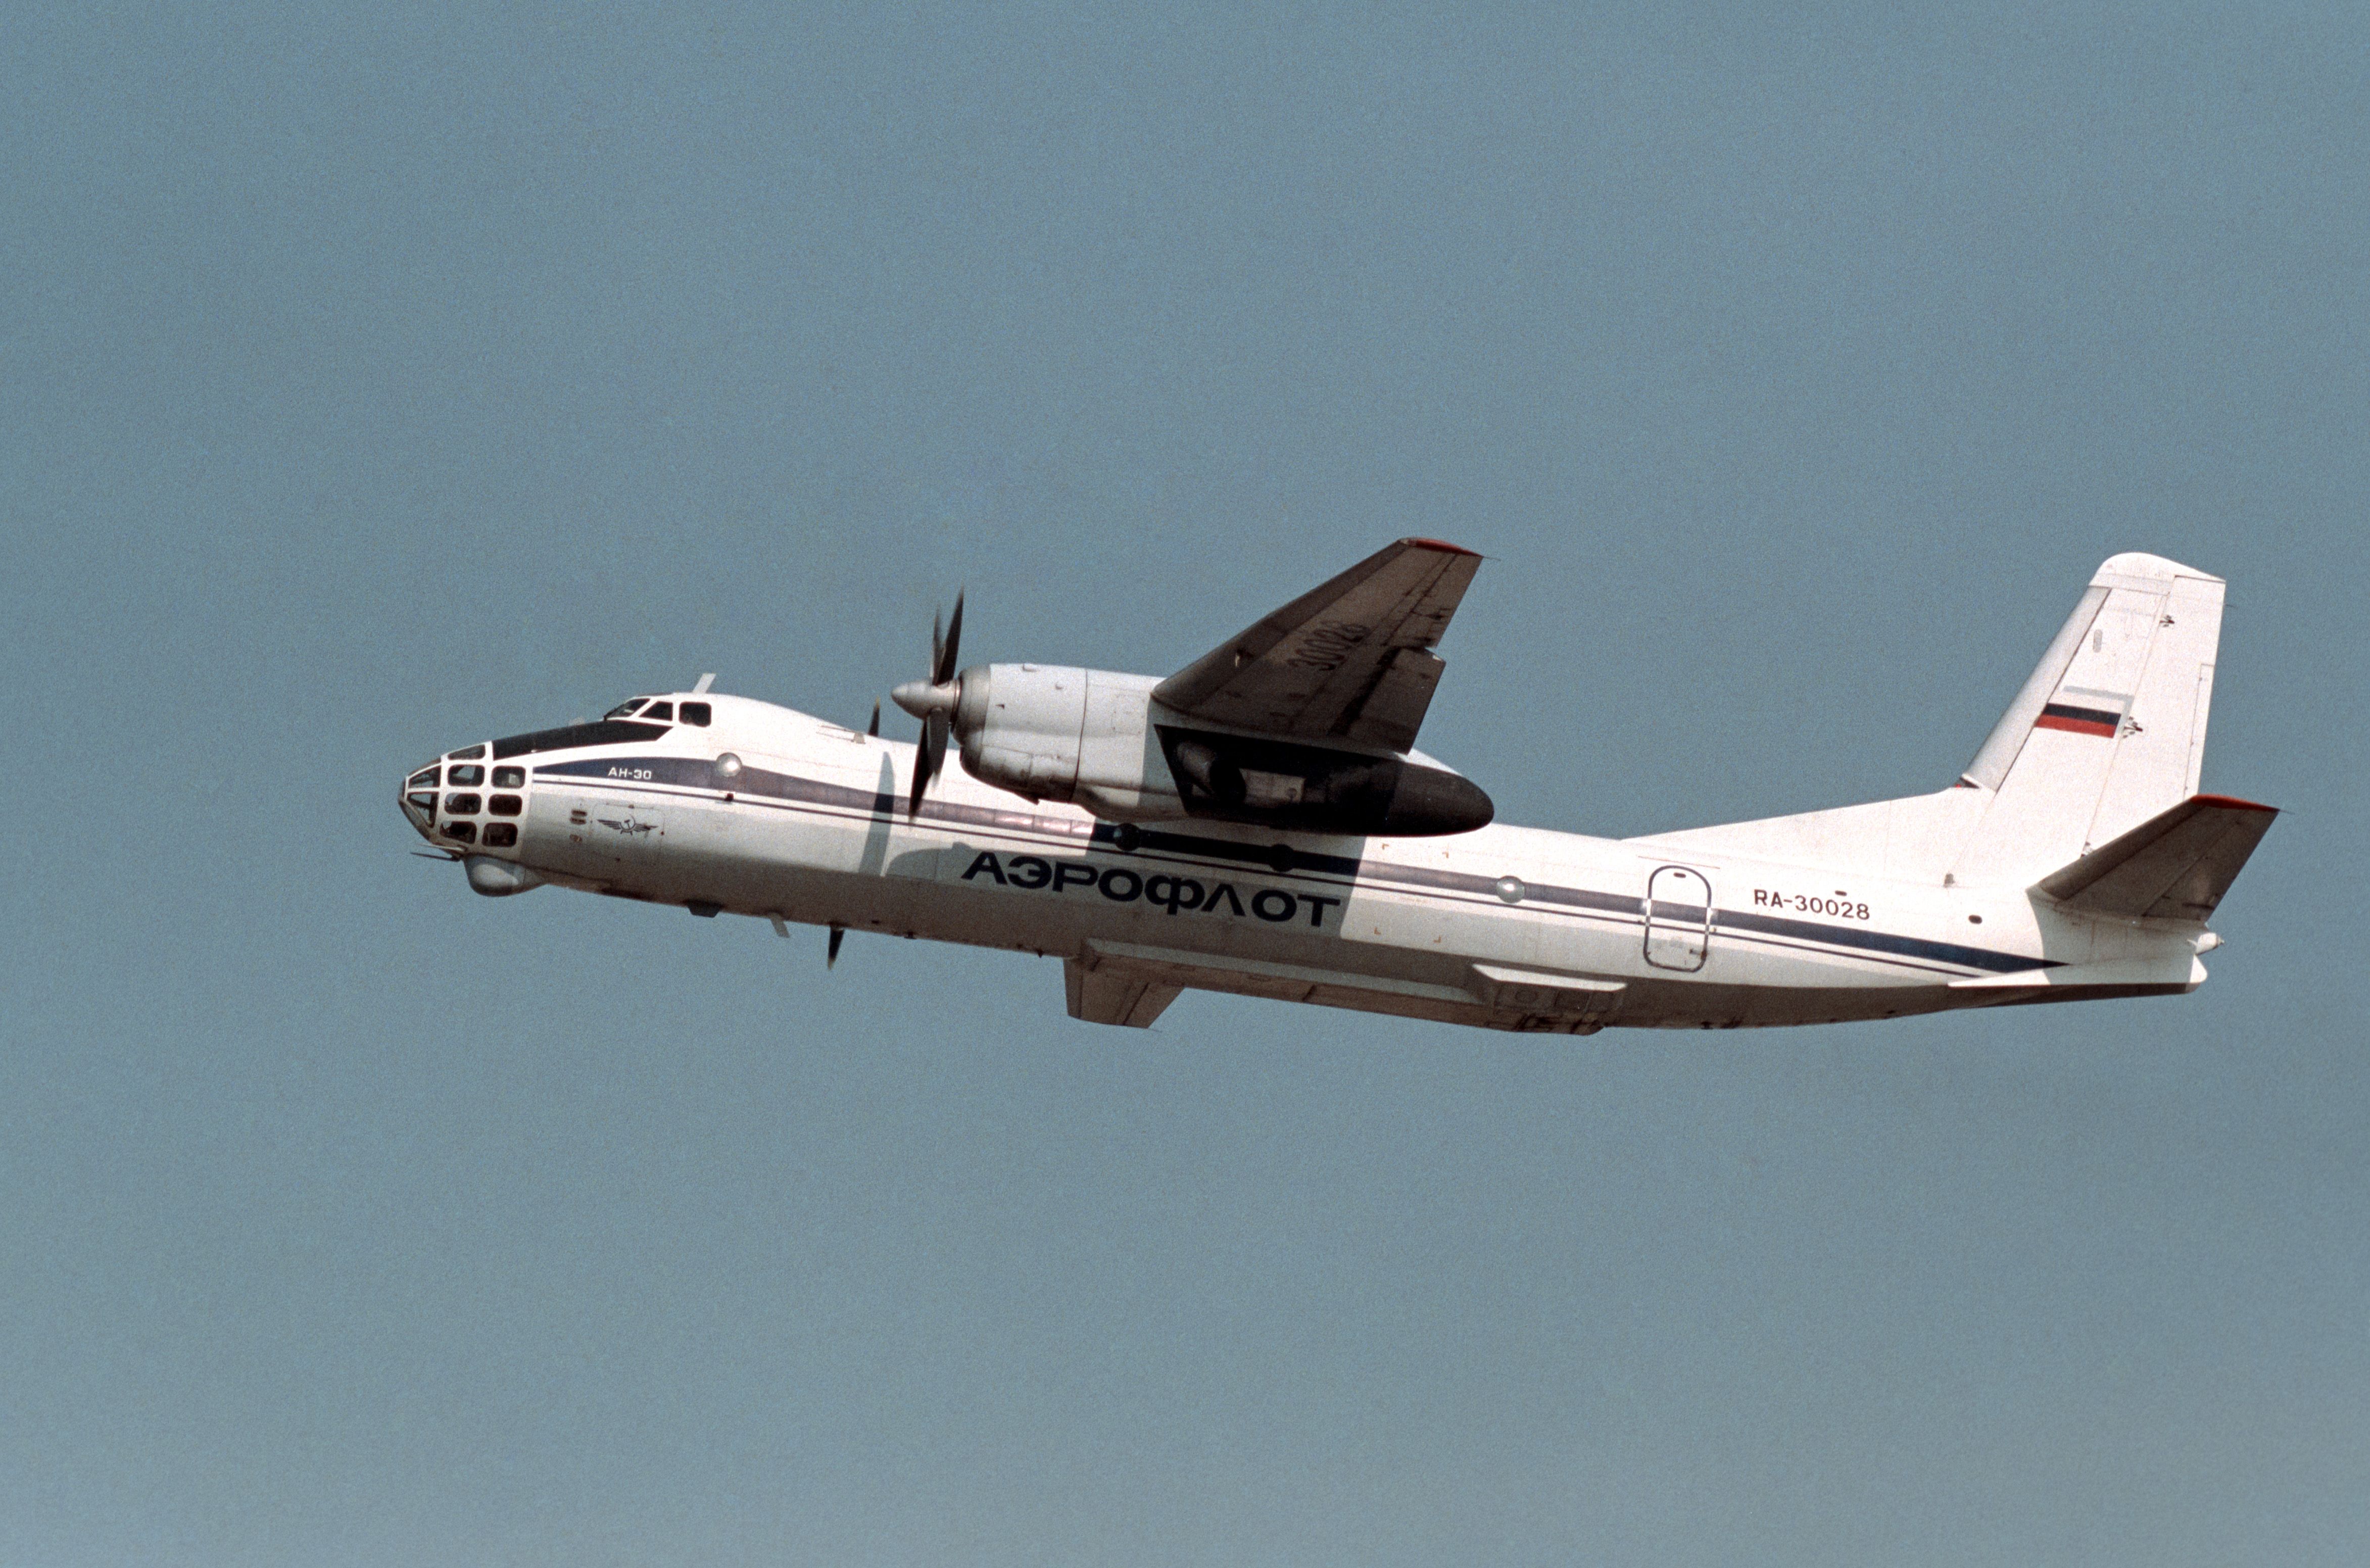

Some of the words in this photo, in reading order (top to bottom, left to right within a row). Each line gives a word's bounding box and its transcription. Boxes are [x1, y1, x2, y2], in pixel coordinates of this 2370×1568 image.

[608, 767, 652, 780] АН-30
[961, 851, 1341, 927] АЭРОФЛОТ
[1754, 889, 1870, 920] RA-30028
